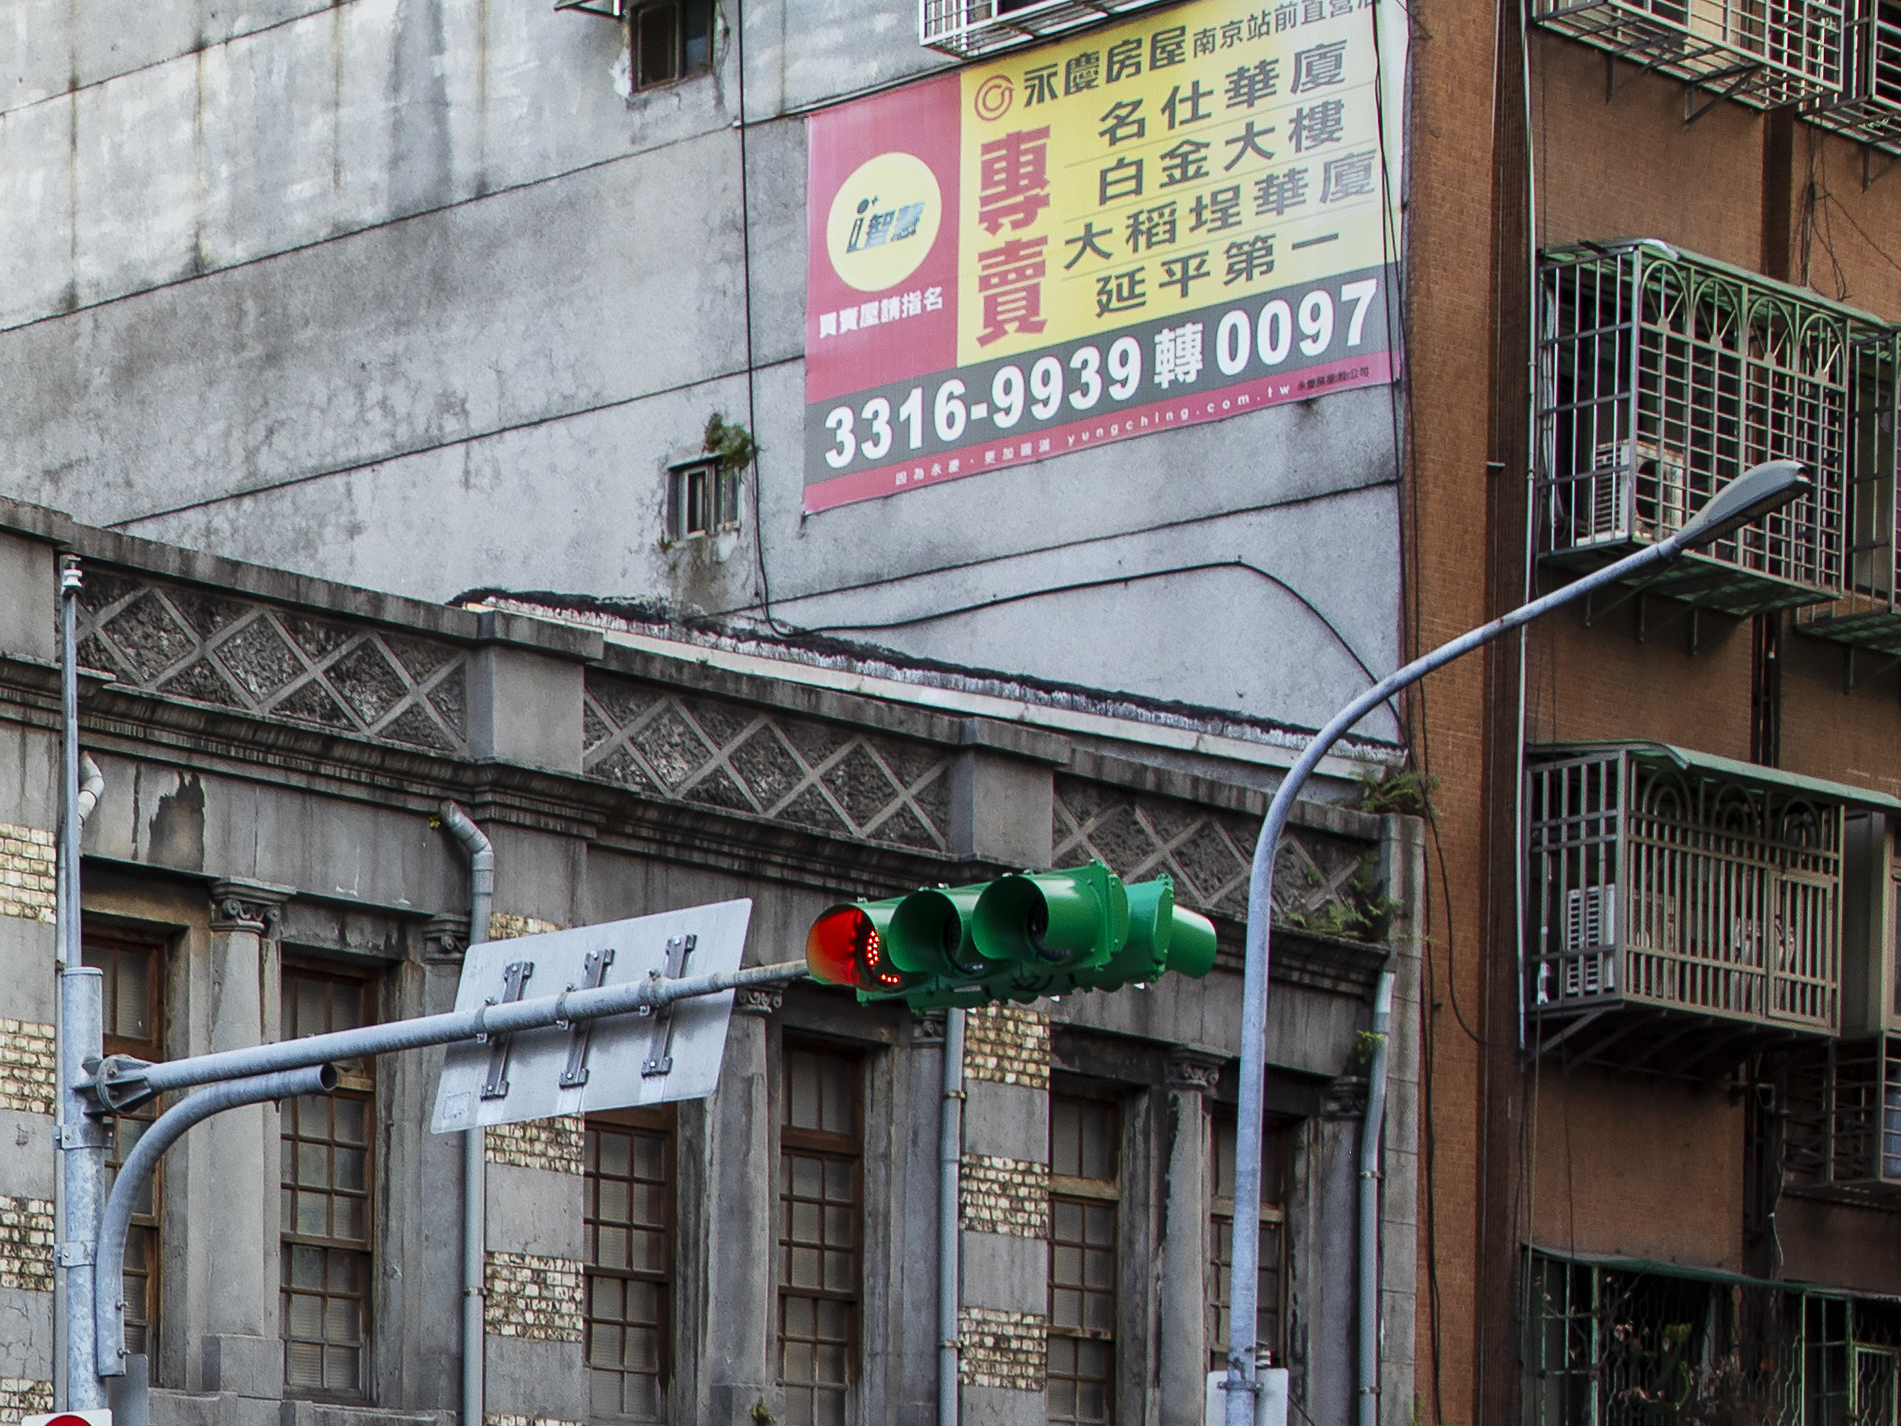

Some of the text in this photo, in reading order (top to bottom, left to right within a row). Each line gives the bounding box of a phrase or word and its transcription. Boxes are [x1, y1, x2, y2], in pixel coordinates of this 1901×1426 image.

[1024, 25, 1186, 107] 永慶房屋
[1098, 39, 1347, 146] 名仕華廈
[1099, 99, 1345, 206] 白金大樓
[976, 124, 1051, 348] 專賣
[1064, 148, 1377, 271] 大稻埕華廈
[1096, 232, 1340, 318] 延平第一
[1067, 383, 1290, 447] yungching.com.tw
